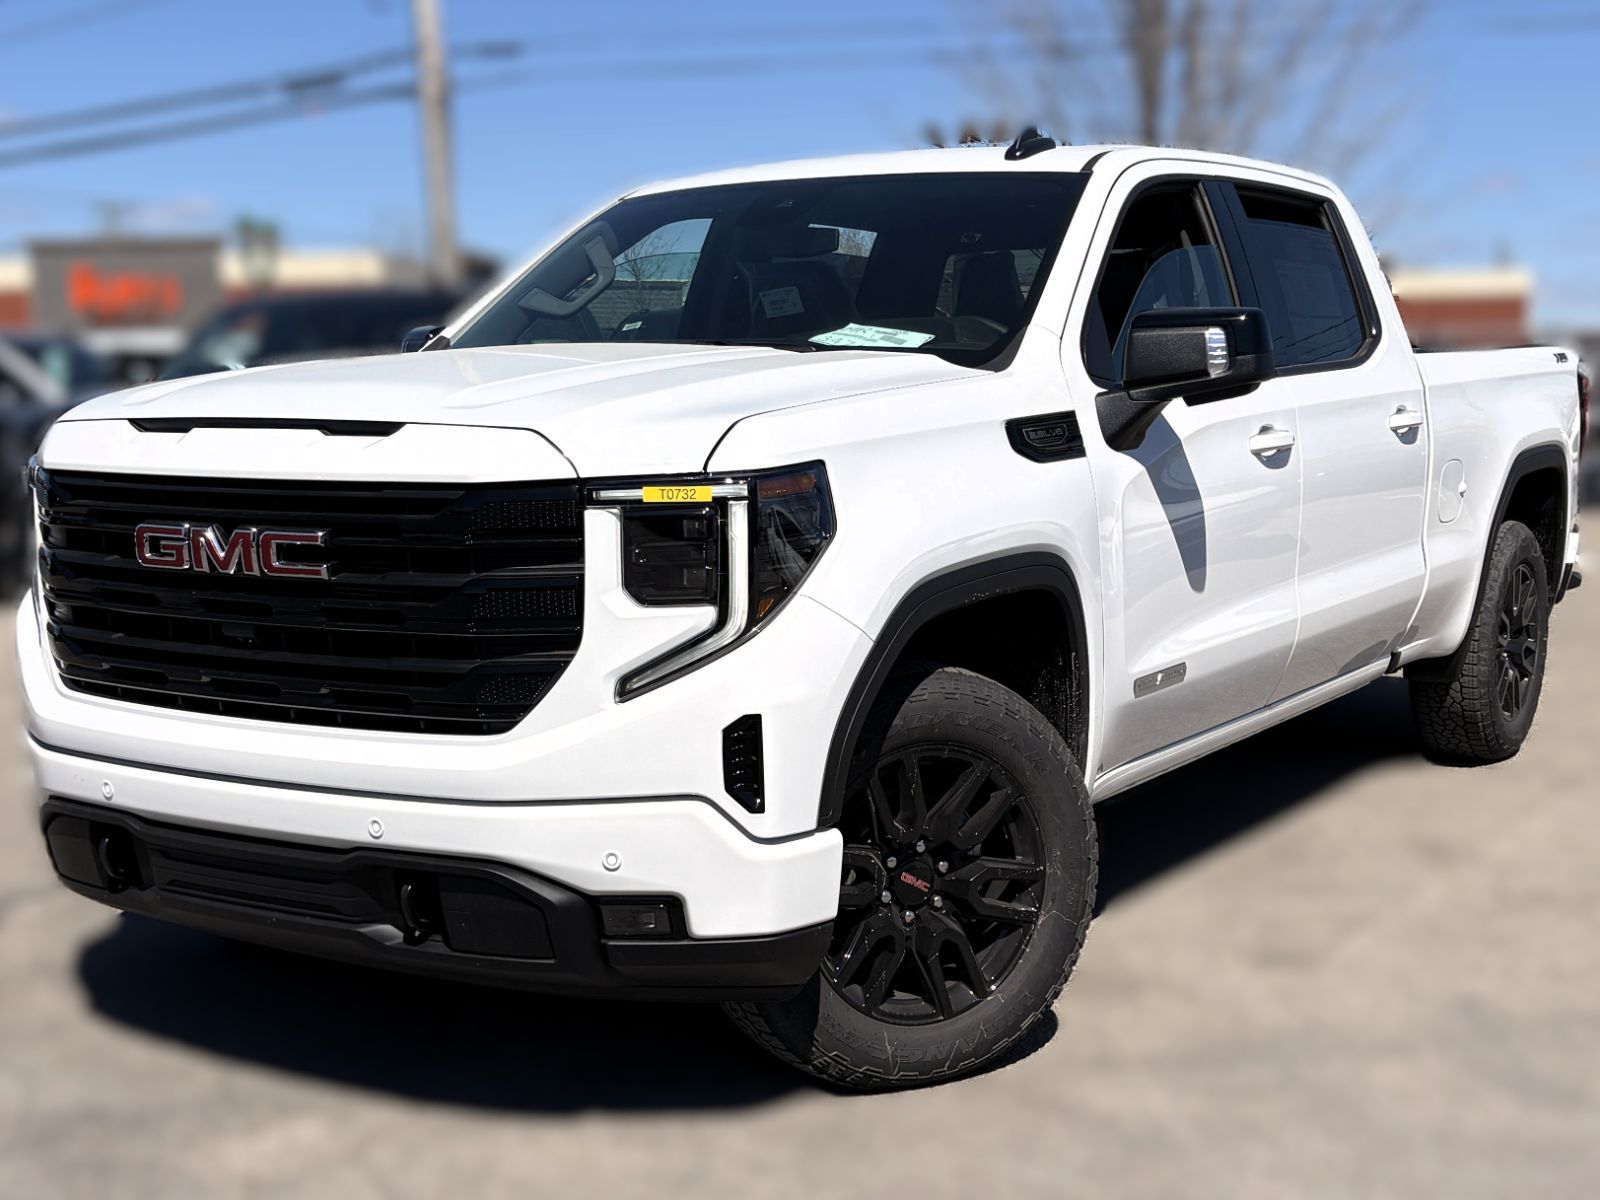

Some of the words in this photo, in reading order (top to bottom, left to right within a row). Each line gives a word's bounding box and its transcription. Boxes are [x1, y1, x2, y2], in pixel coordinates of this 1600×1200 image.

[658, 488, 697, 500] T0732
[134, 522, 330, 580] GMC
[900, 871, 931, 893] GMC
